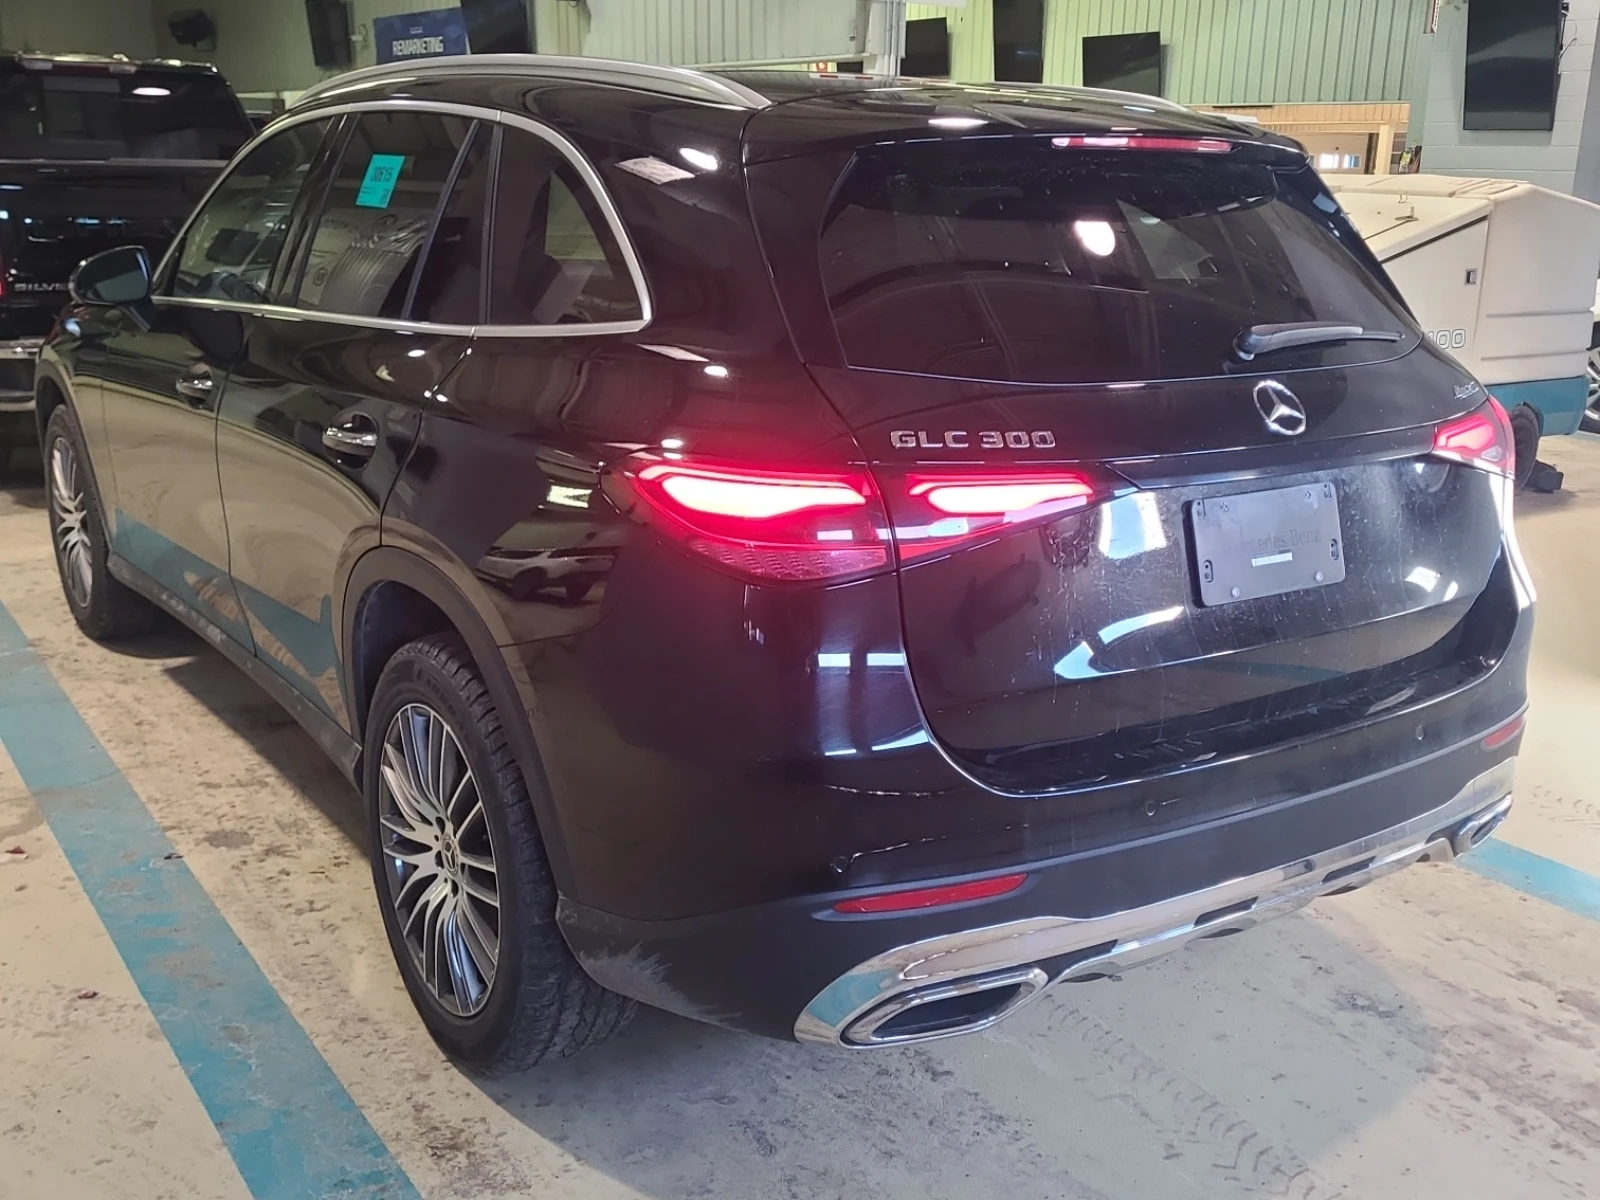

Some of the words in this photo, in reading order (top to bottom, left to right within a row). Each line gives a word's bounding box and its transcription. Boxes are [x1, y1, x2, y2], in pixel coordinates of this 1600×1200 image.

[392, 36, 444, 56] REMARKETING
[890, 430, 969, 449] GLC
[979, 430, 1056, 448] 300
